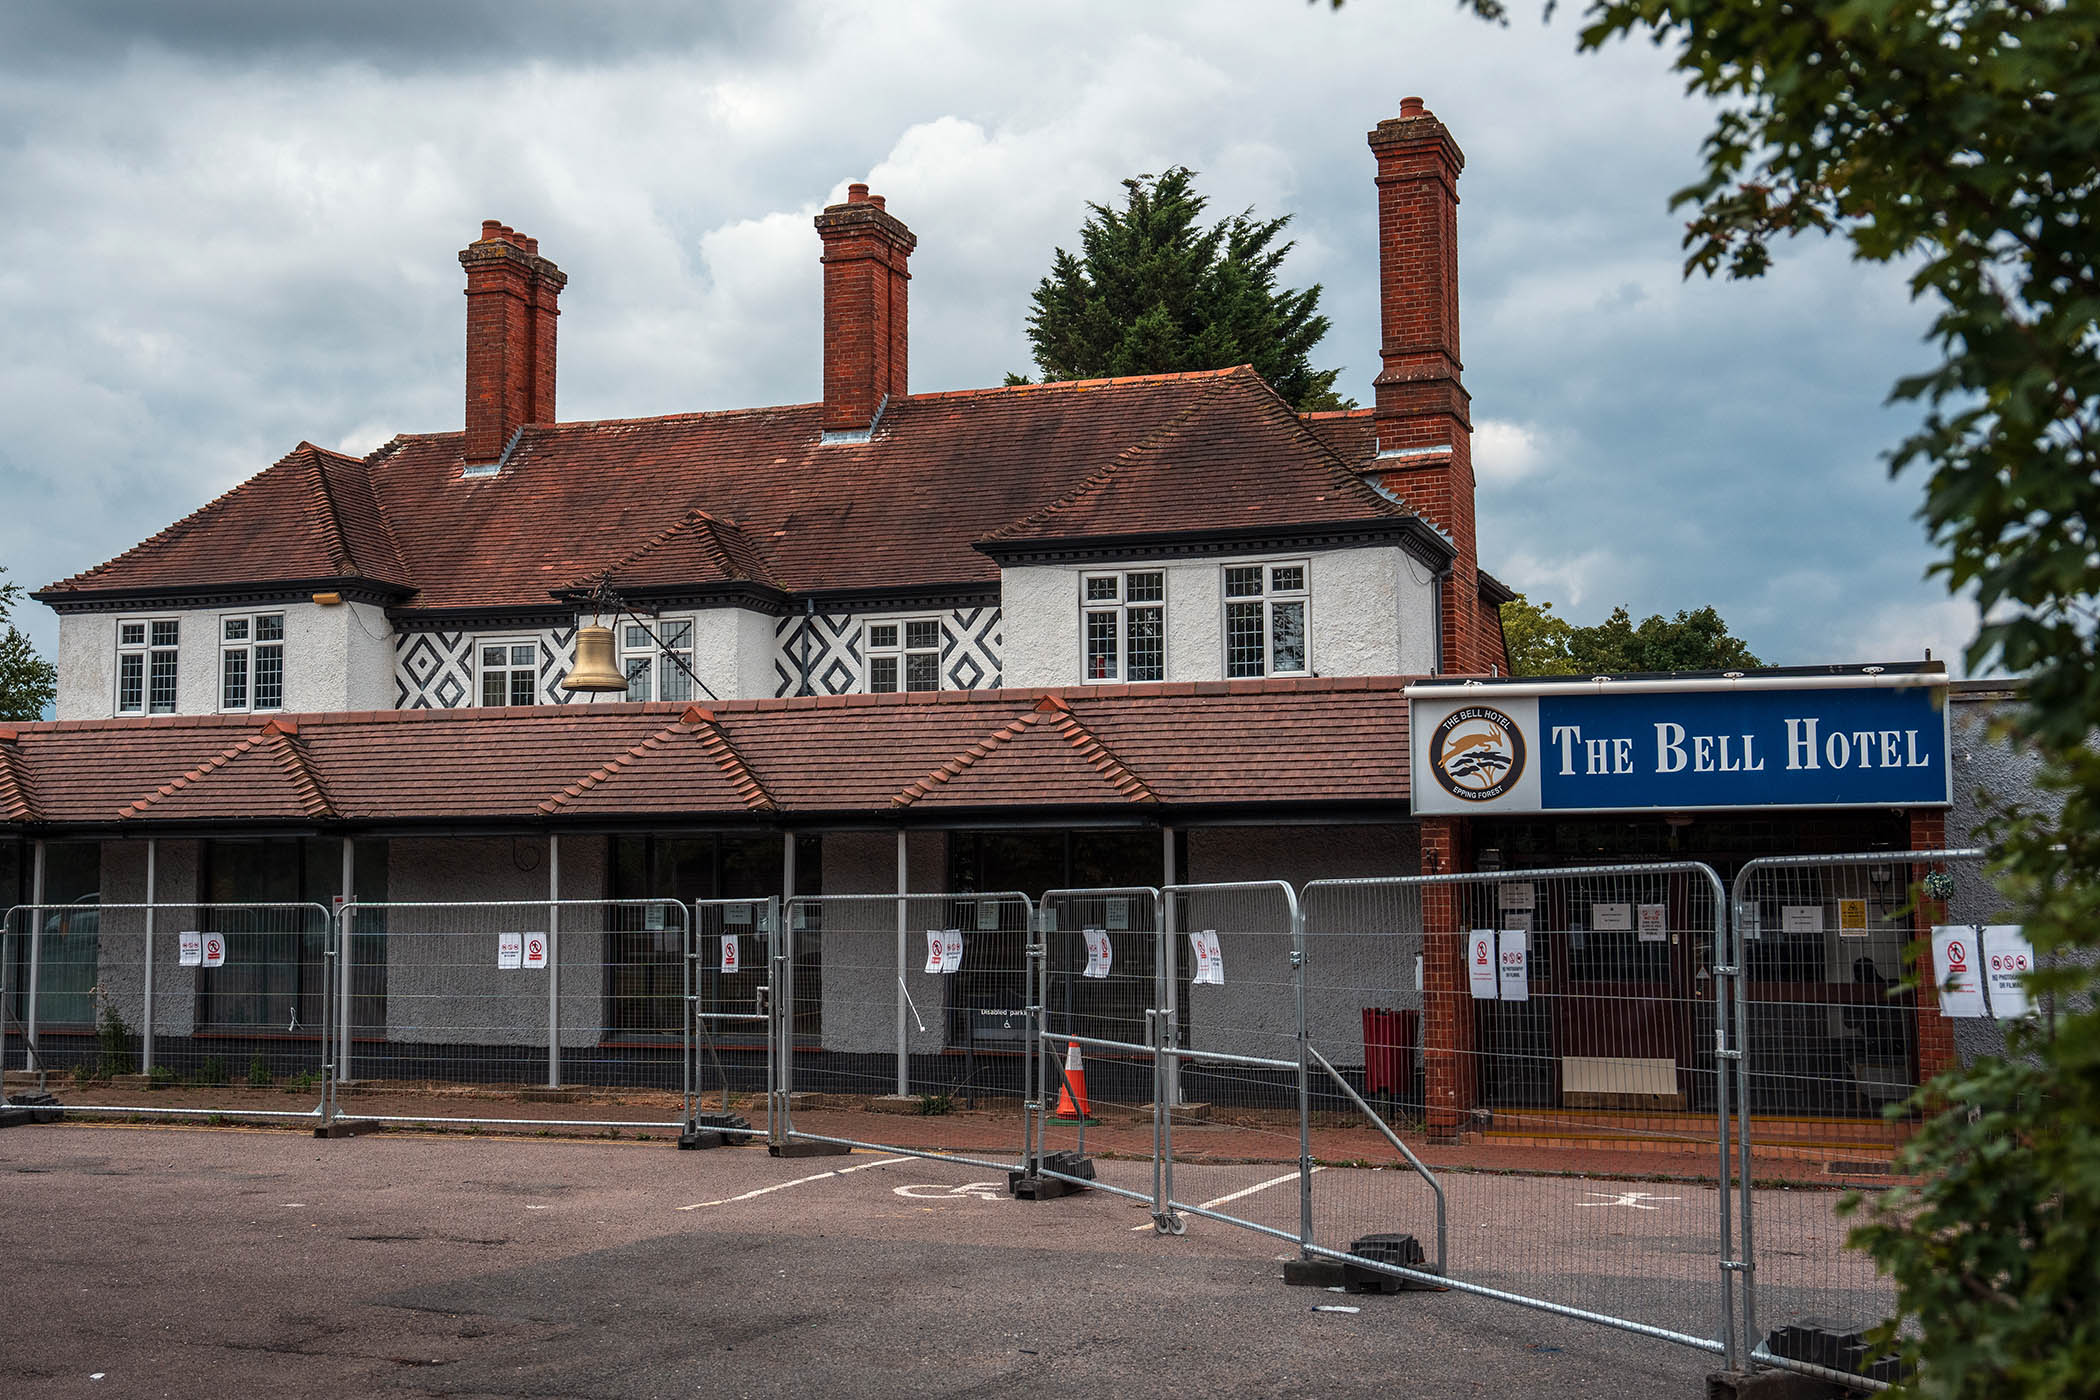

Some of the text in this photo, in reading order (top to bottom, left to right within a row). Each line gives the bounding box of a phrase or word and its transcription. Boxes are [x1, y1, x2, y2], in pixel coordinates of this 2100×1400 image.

[1442, 708, 1511, 730] THE BELL HOTEL
[1452, 785, 1503, 799] EPPING FOREST
